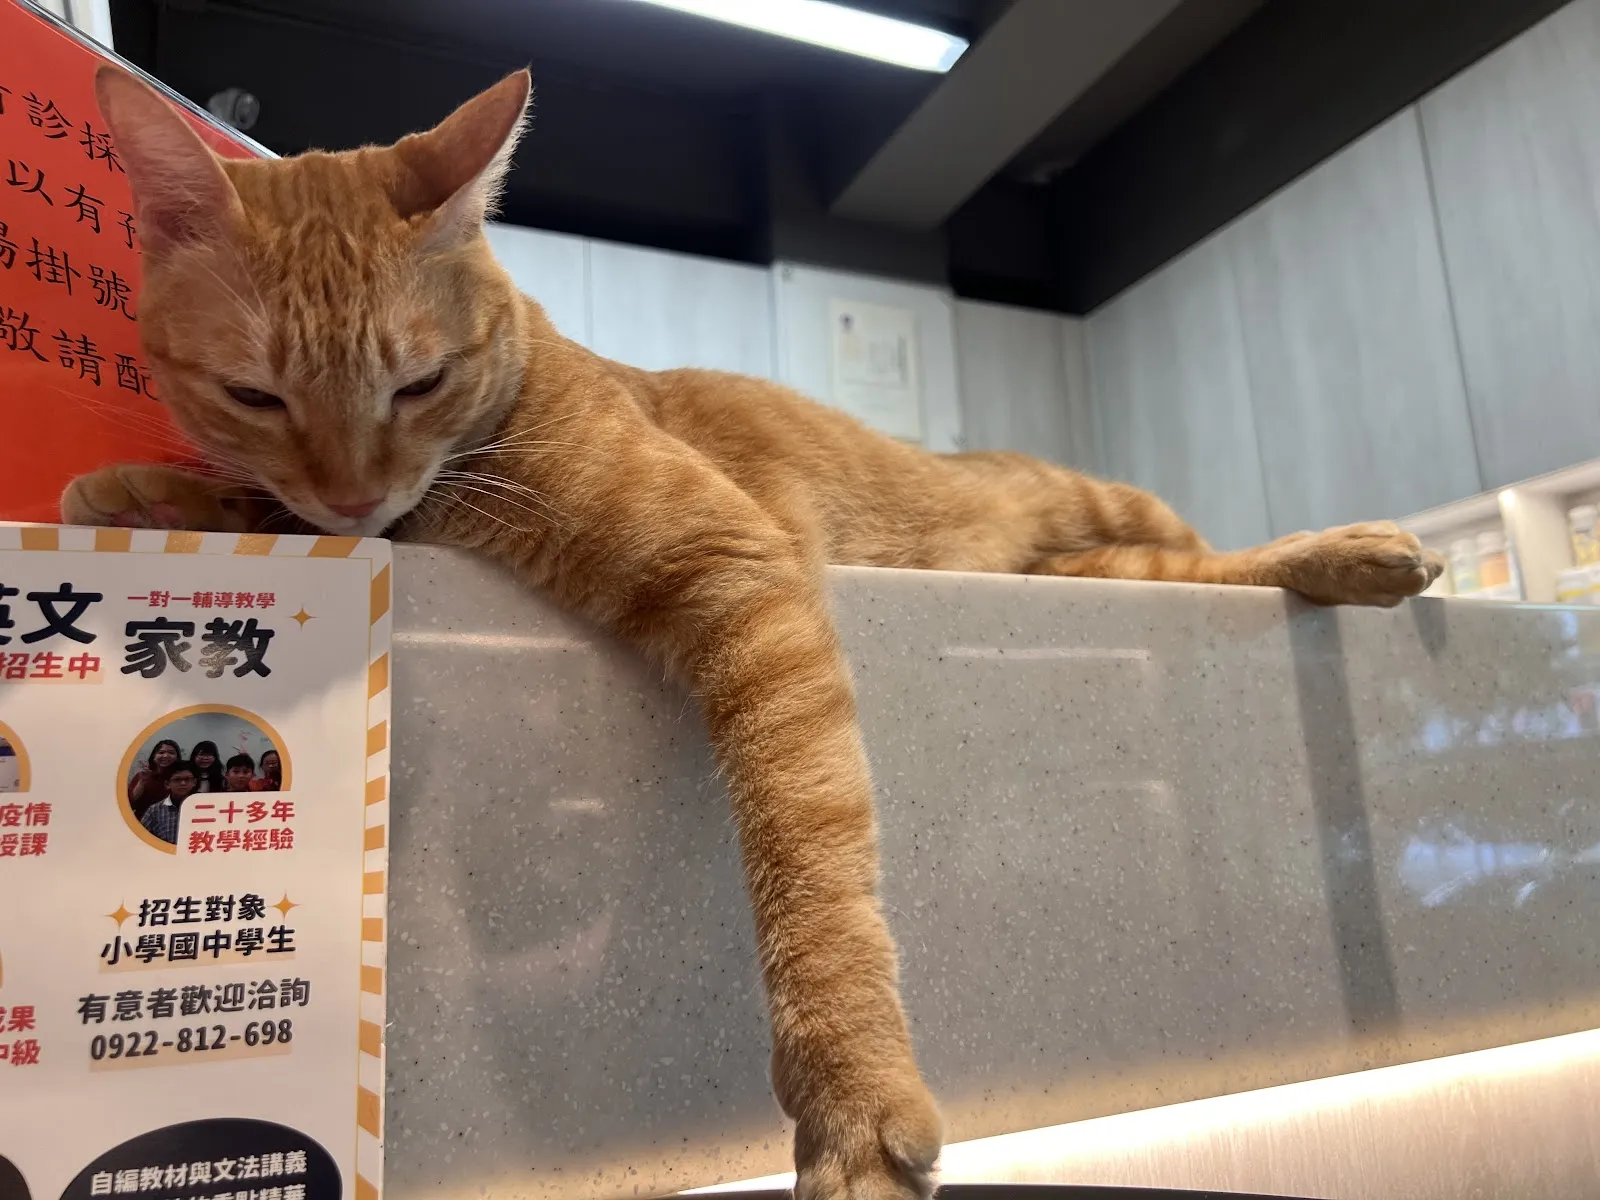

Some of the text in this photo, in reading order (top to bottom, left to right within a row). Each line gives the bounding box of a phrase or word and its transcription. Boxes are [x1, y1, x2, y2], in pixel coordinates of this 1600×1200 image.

[0, 85, 127, 174] 診採
[0, 582, 104, 645] 文
[127, 590, 276, 609] 一對一輔導教學
[0, 651, 101, 680] 招生中
[120, 616, 276, 679] 家教
[0, 802, 53, 827] 疫情
[191, 800, 296, 824] 二十多年
[188, 828, 295, 854] 教學經驗
[138, 893, 267, 928] 招生對象
[100, 924, 297, 966] 小學國中學生
[77, 976, 311, 1026] 有意者歡迎洽詢
[90, 1018, 293, 1061] 0922-812-698
[90, 1149, 308, 1197] 自編教材與文法講義
